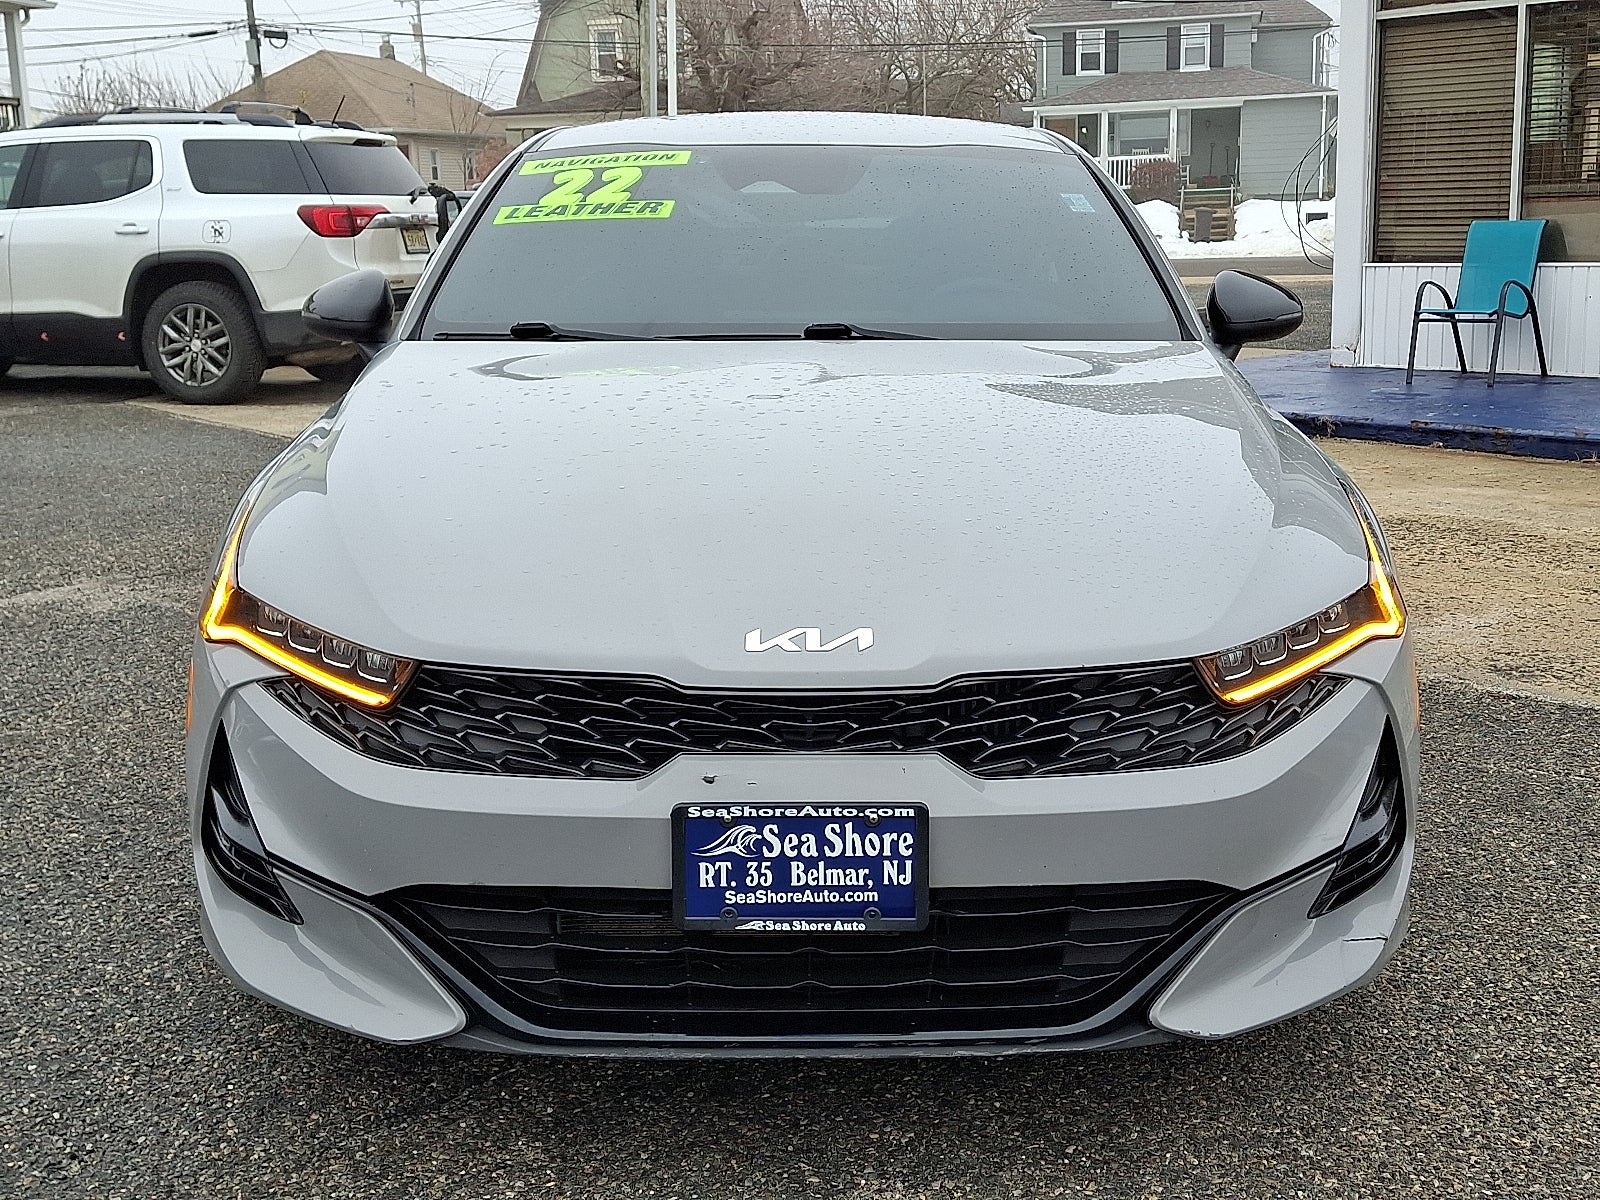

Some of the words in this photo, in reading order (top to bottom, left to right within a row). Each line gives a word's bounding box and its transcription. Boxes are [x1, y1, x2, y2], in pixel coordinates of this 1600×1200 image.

[534, 152, 677, 170] NAVIGATION
[538, 166, 643, 203] 22
[504, 201, 668, 219] LEATHER
[744, 627, 874, 652] KIA
[687, 806, 915, 818] SeaShoreAuto.com
[762, 824, 818, 858] Sea
[824, 822, 914, 857] Shore
[698, 862, 737, 888] RT.
[745, 862, 773, 887] 35
[790, 861, 873, 889] Belmar,
[882, 860, 913, 886] NJ
[725, 889, 878, 904] SeaShoreAuto.com
[765, 921, 790, 931] Sea
[792, 921, 831, 931] Shore
[832, 921, 866, 931] Auto
